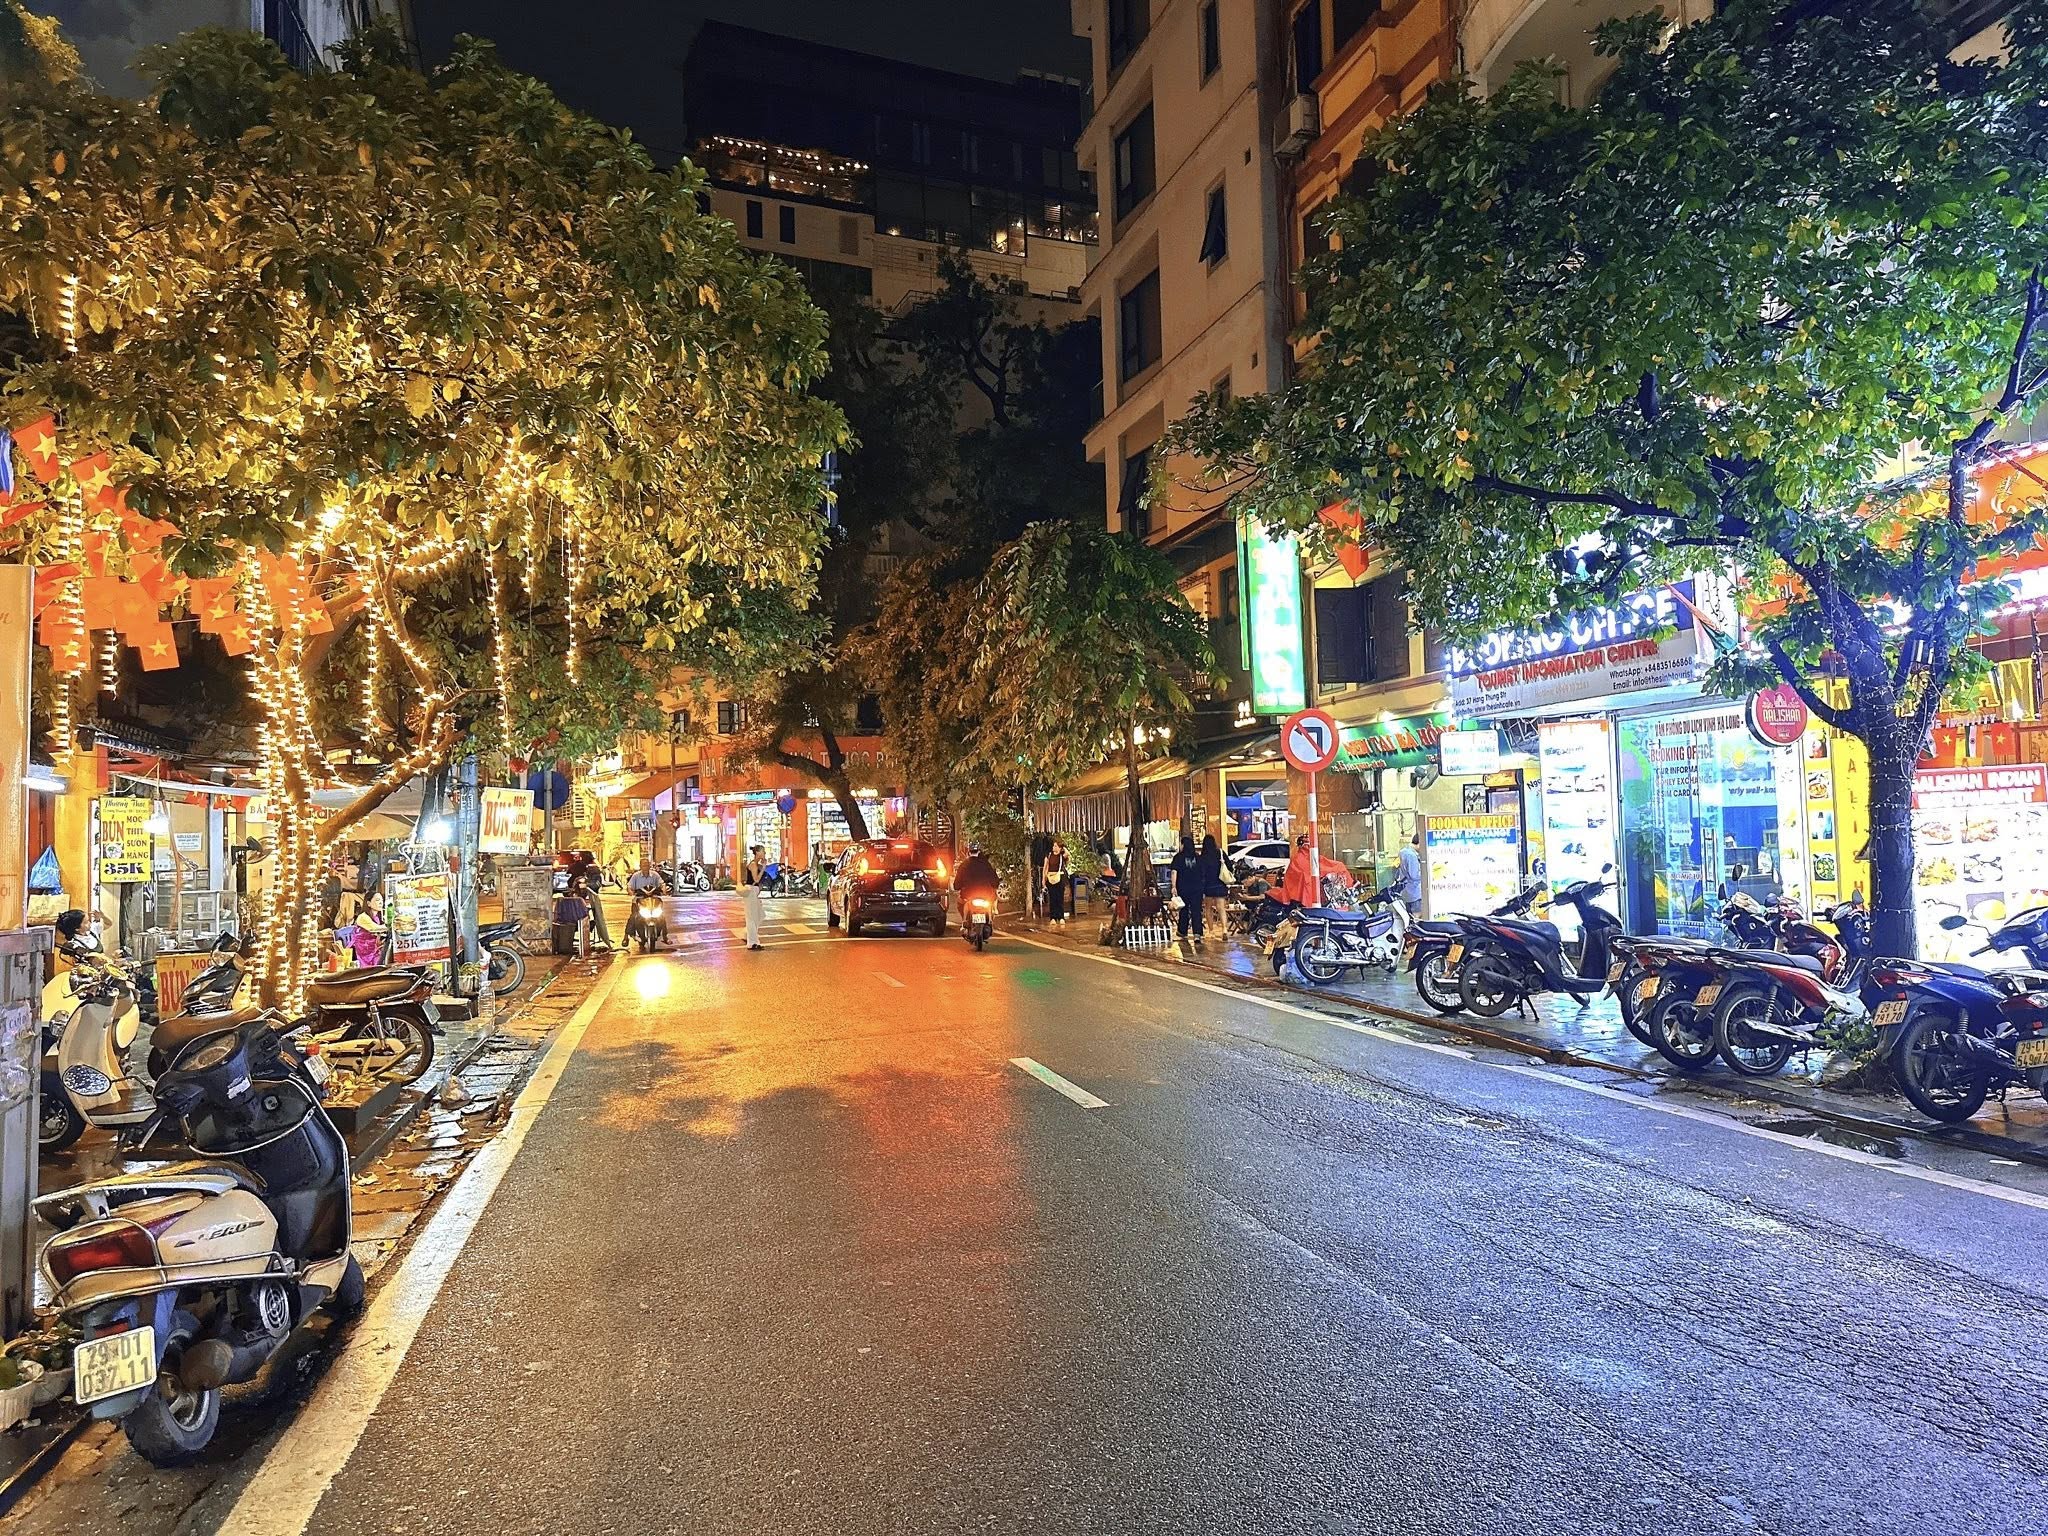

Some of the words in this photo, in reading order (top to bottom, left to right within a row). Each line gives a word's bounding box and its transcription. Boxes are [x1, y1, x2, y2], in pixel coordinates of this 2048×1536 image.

[1476, 666, 1521, 689] TOURIST
[1523, 649, 1602, 681] INFORMATION
[1610, 665, 1643, 679] WhatsApp:
[1763, 708, 1801, 722] AALISHAN
[1673, 789, 1691, 797] CARD
[102, 814, 124, 842] BÚN
[1429, 816, 1477, 830] BOOKING
[1480, 815, 1513, 828] OFFICE
[104, 862, 145, 875] 35K
[396, 938, 419, 949] 25K
[160, 958, 190, 1013] BÚN
[2021, 1040, 2046, 1054] 29-C1
